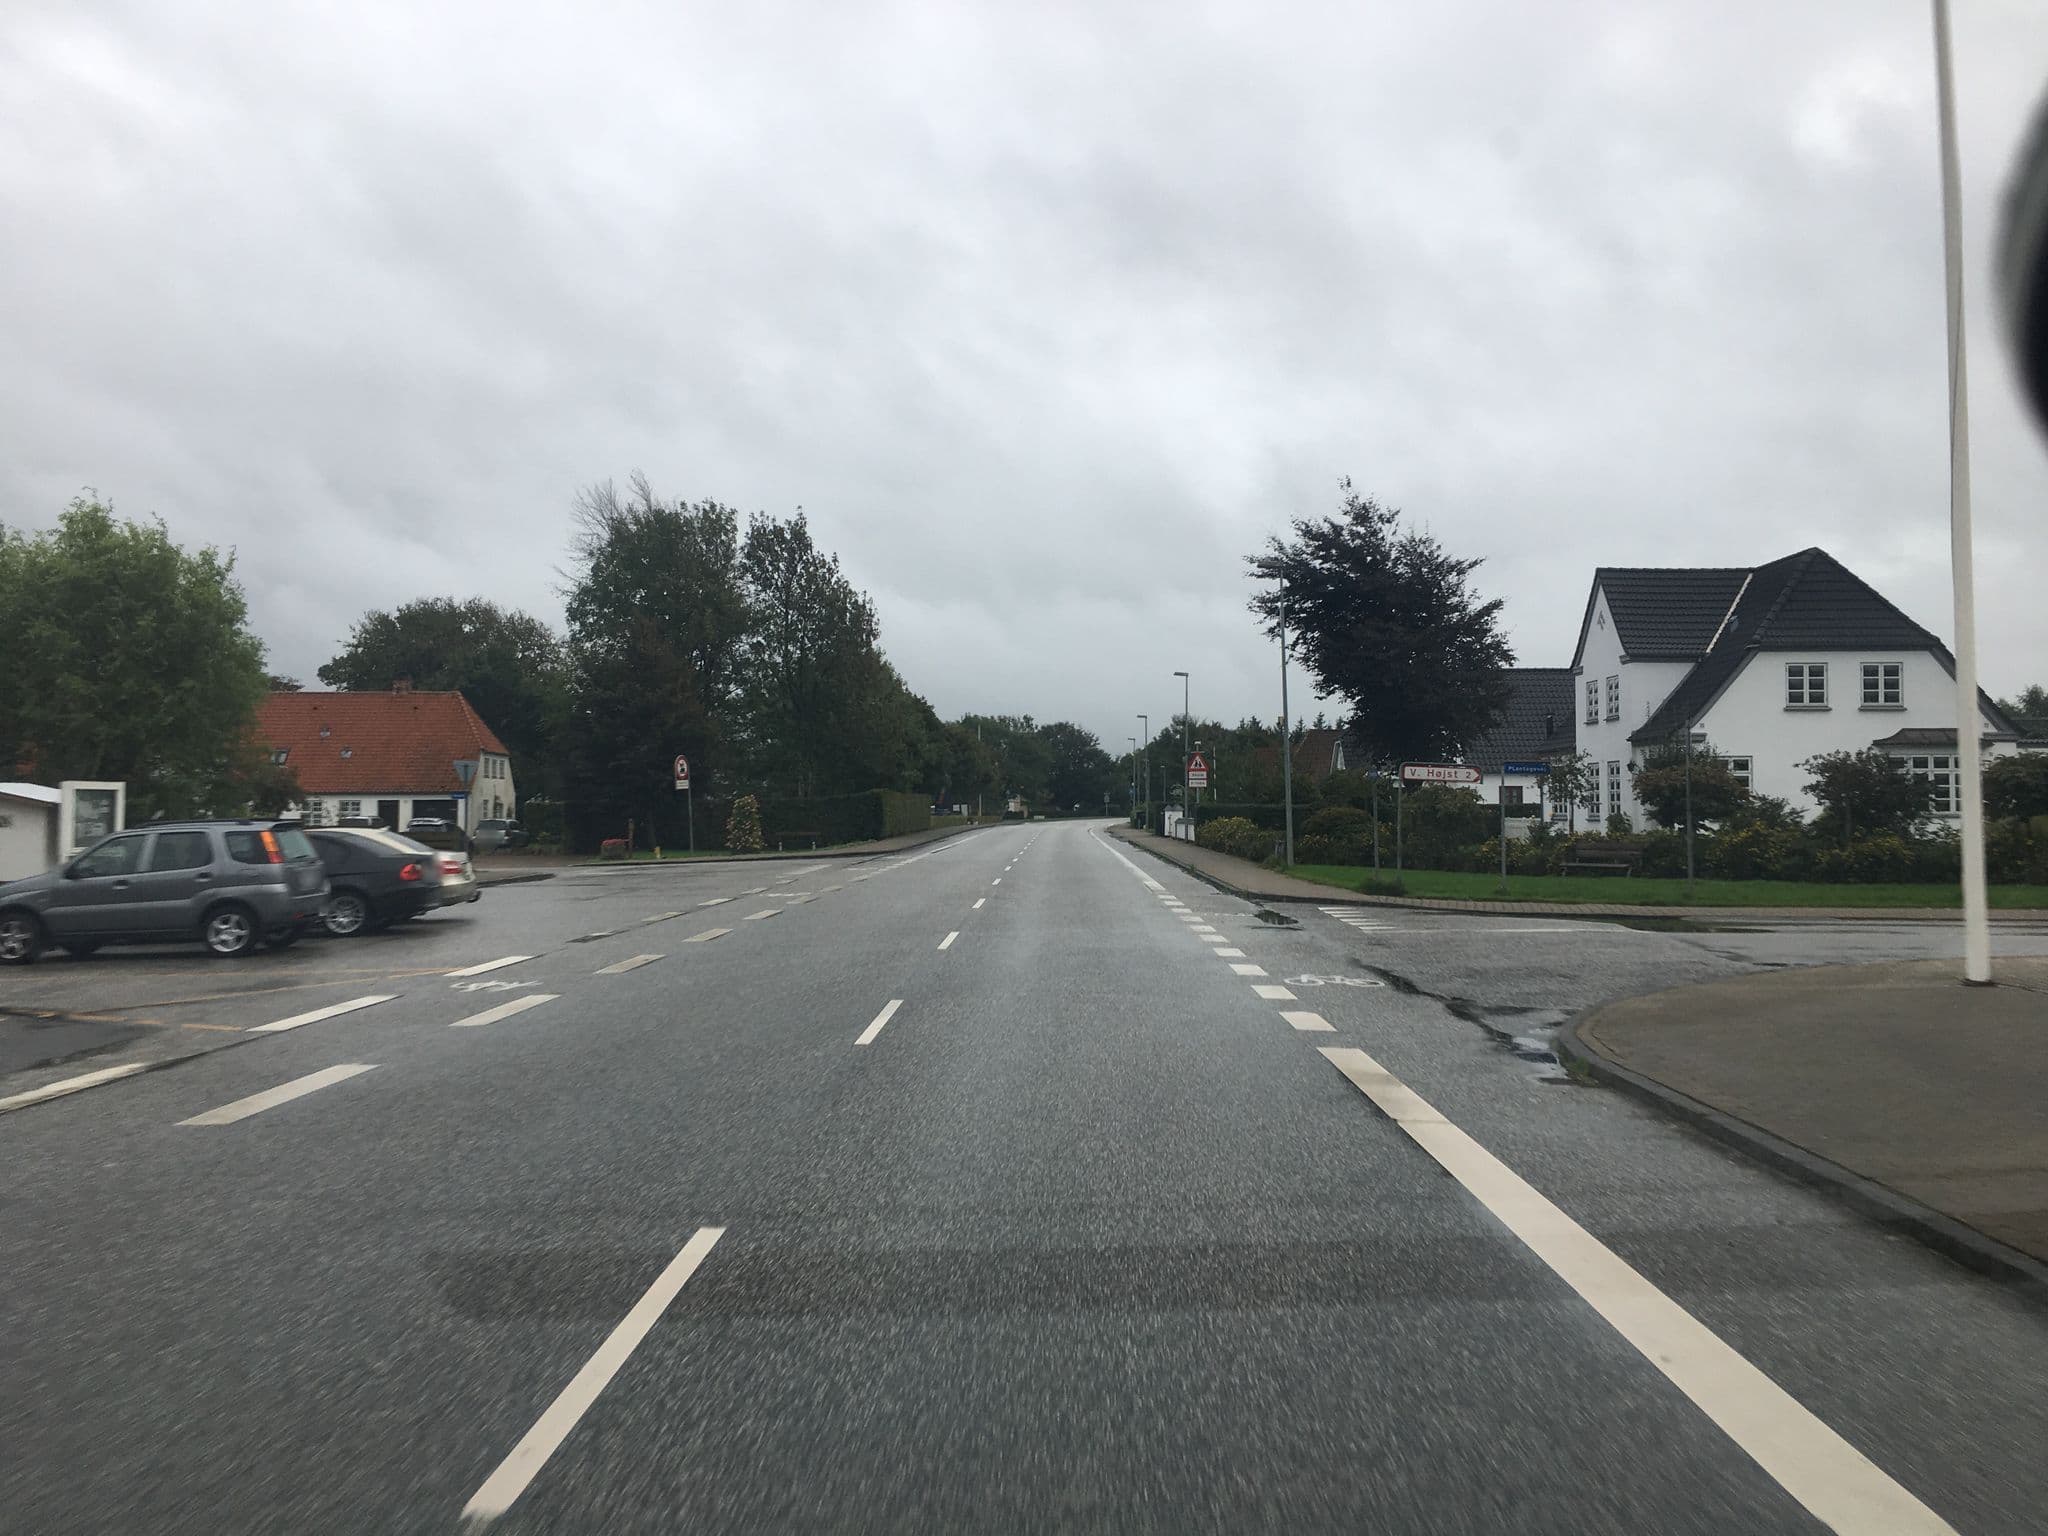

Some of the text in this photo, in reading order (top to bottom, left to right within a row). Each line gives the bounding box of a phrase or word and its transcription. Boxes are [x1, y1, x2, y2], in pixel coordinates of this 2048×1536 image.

[1409, 768, 1472, 779] V. Højst 2
